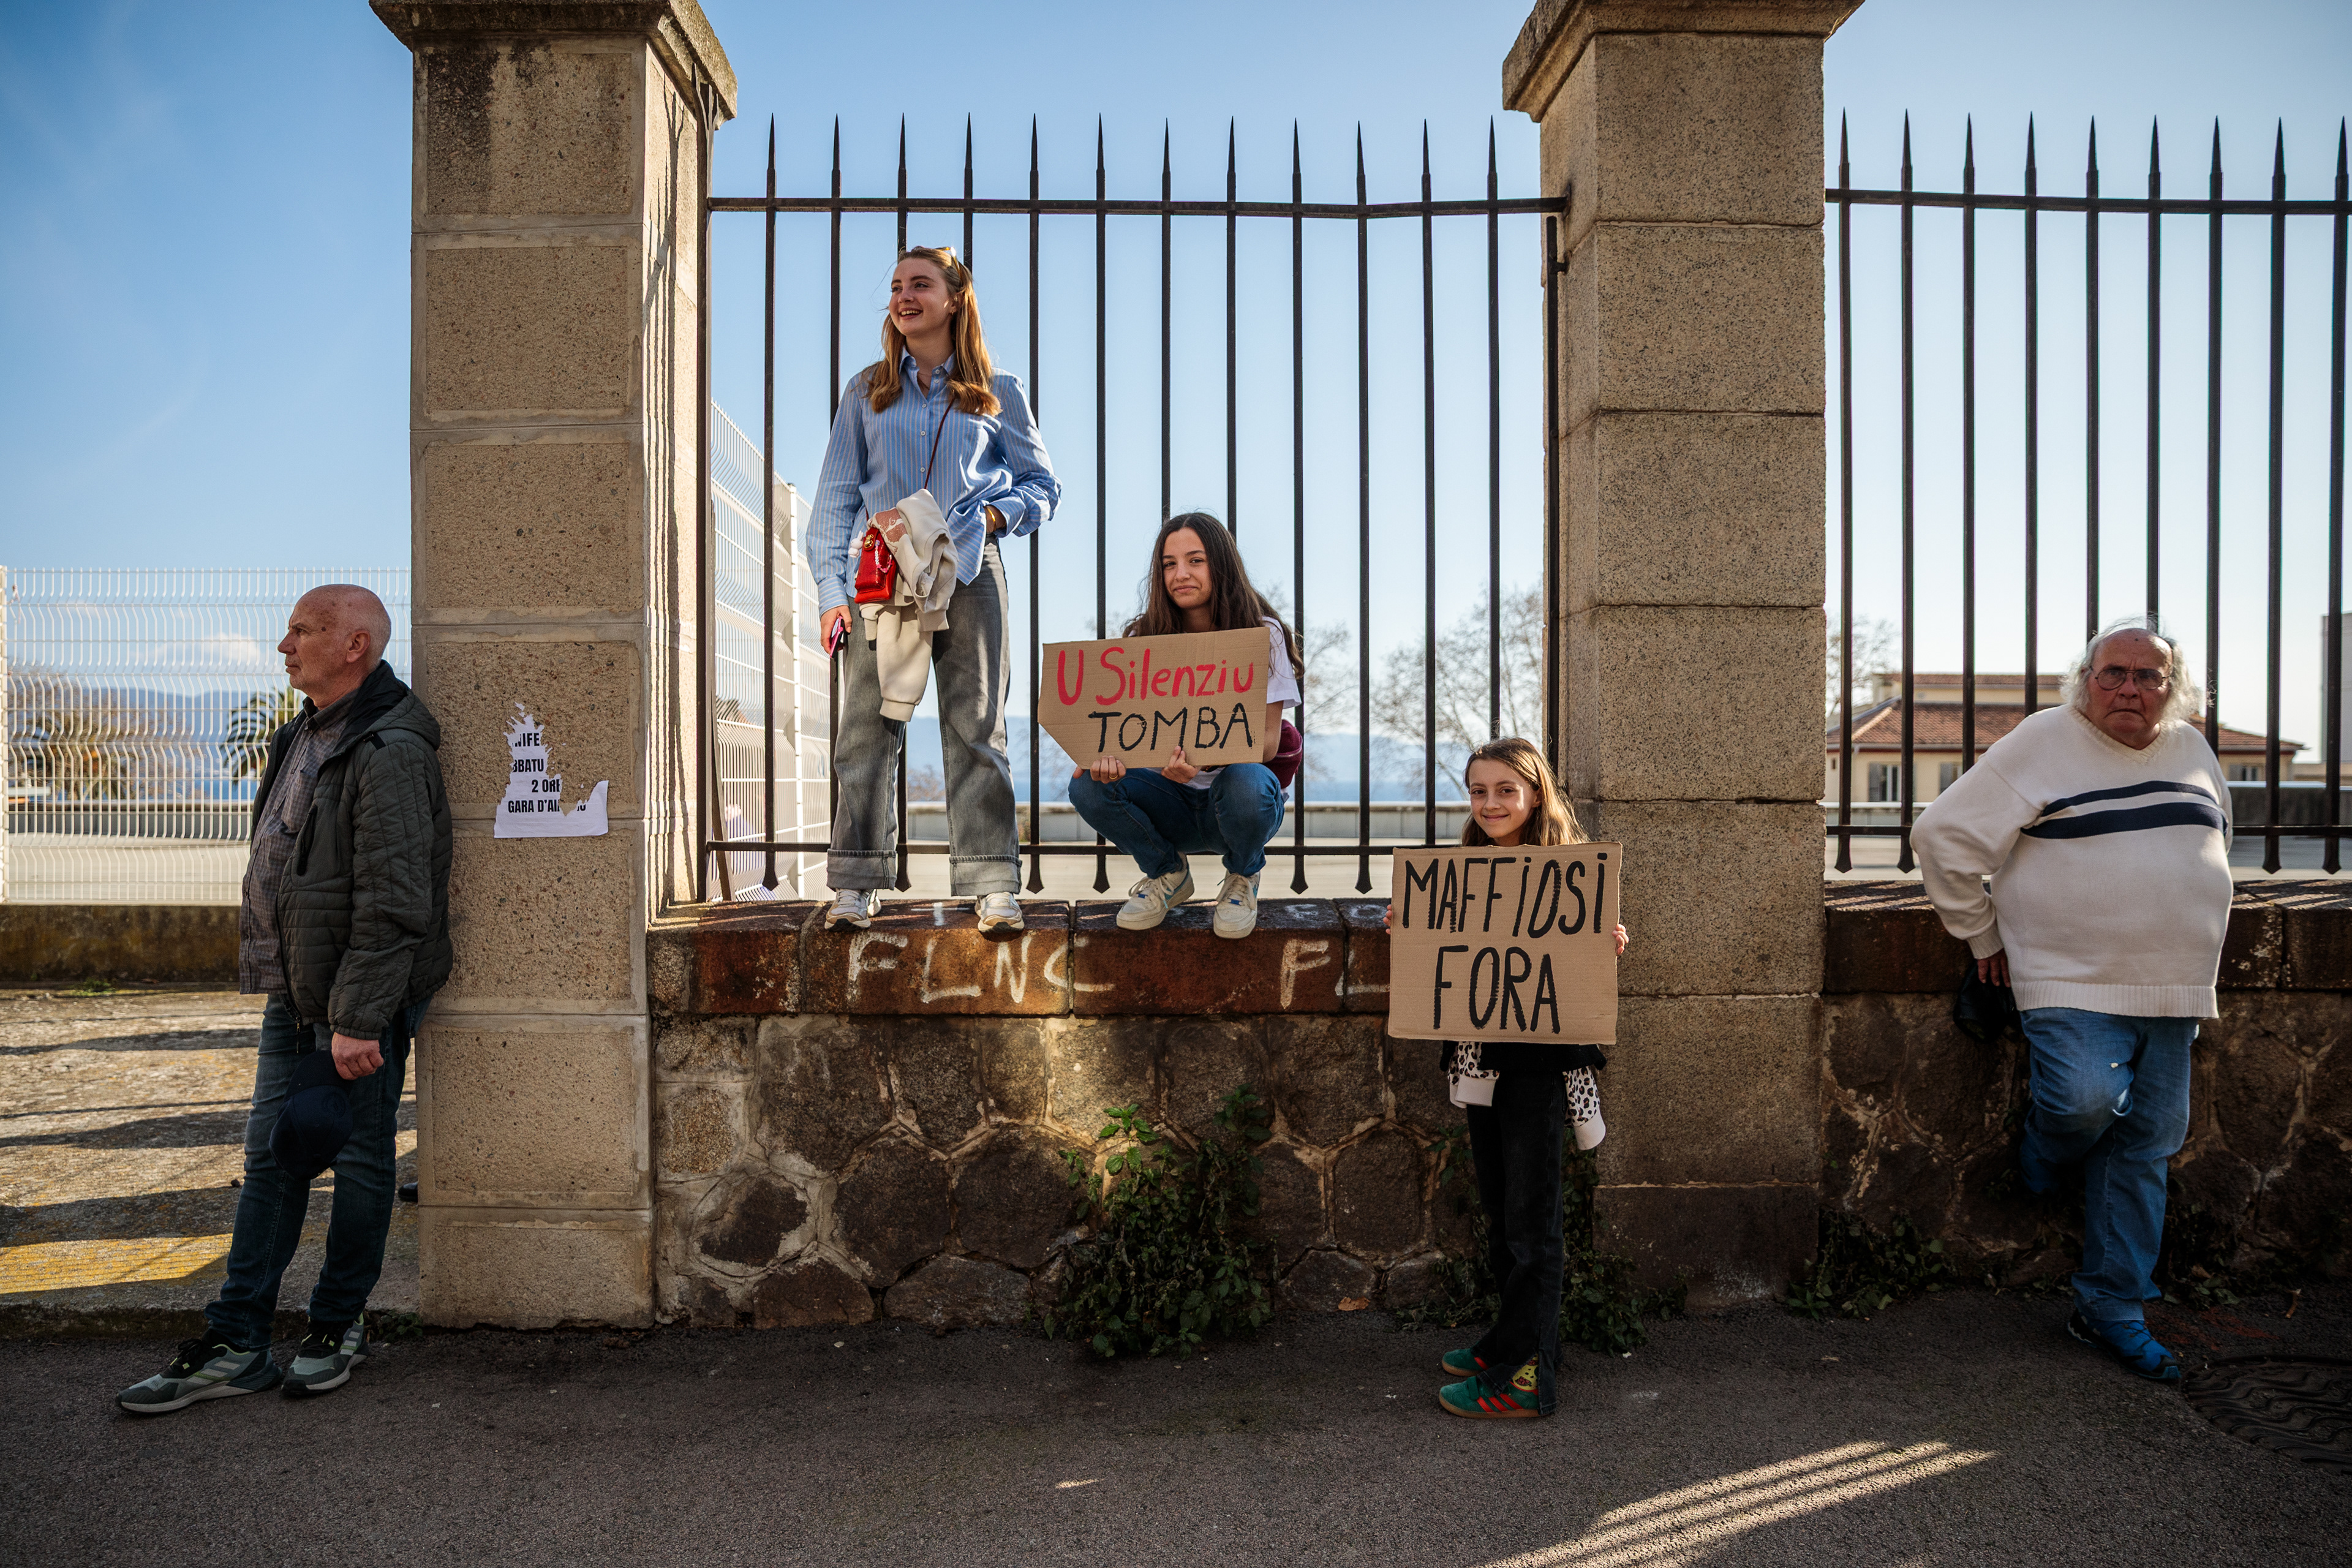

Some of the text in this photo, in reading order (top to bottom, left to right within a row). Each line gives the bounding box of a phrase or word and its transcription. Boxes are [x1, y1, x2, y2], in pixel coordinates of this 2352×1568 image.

[1057, 646, 1254, 706] U Silenziu
[1088, 702, 1254, 753] TOMBA
[508, 800, 535, 813] GARA
[531, 779, 538, 793] 2
[846, 930, 1115, 1005] FLNC
[1433, 945, 1561, 1035] FORA
